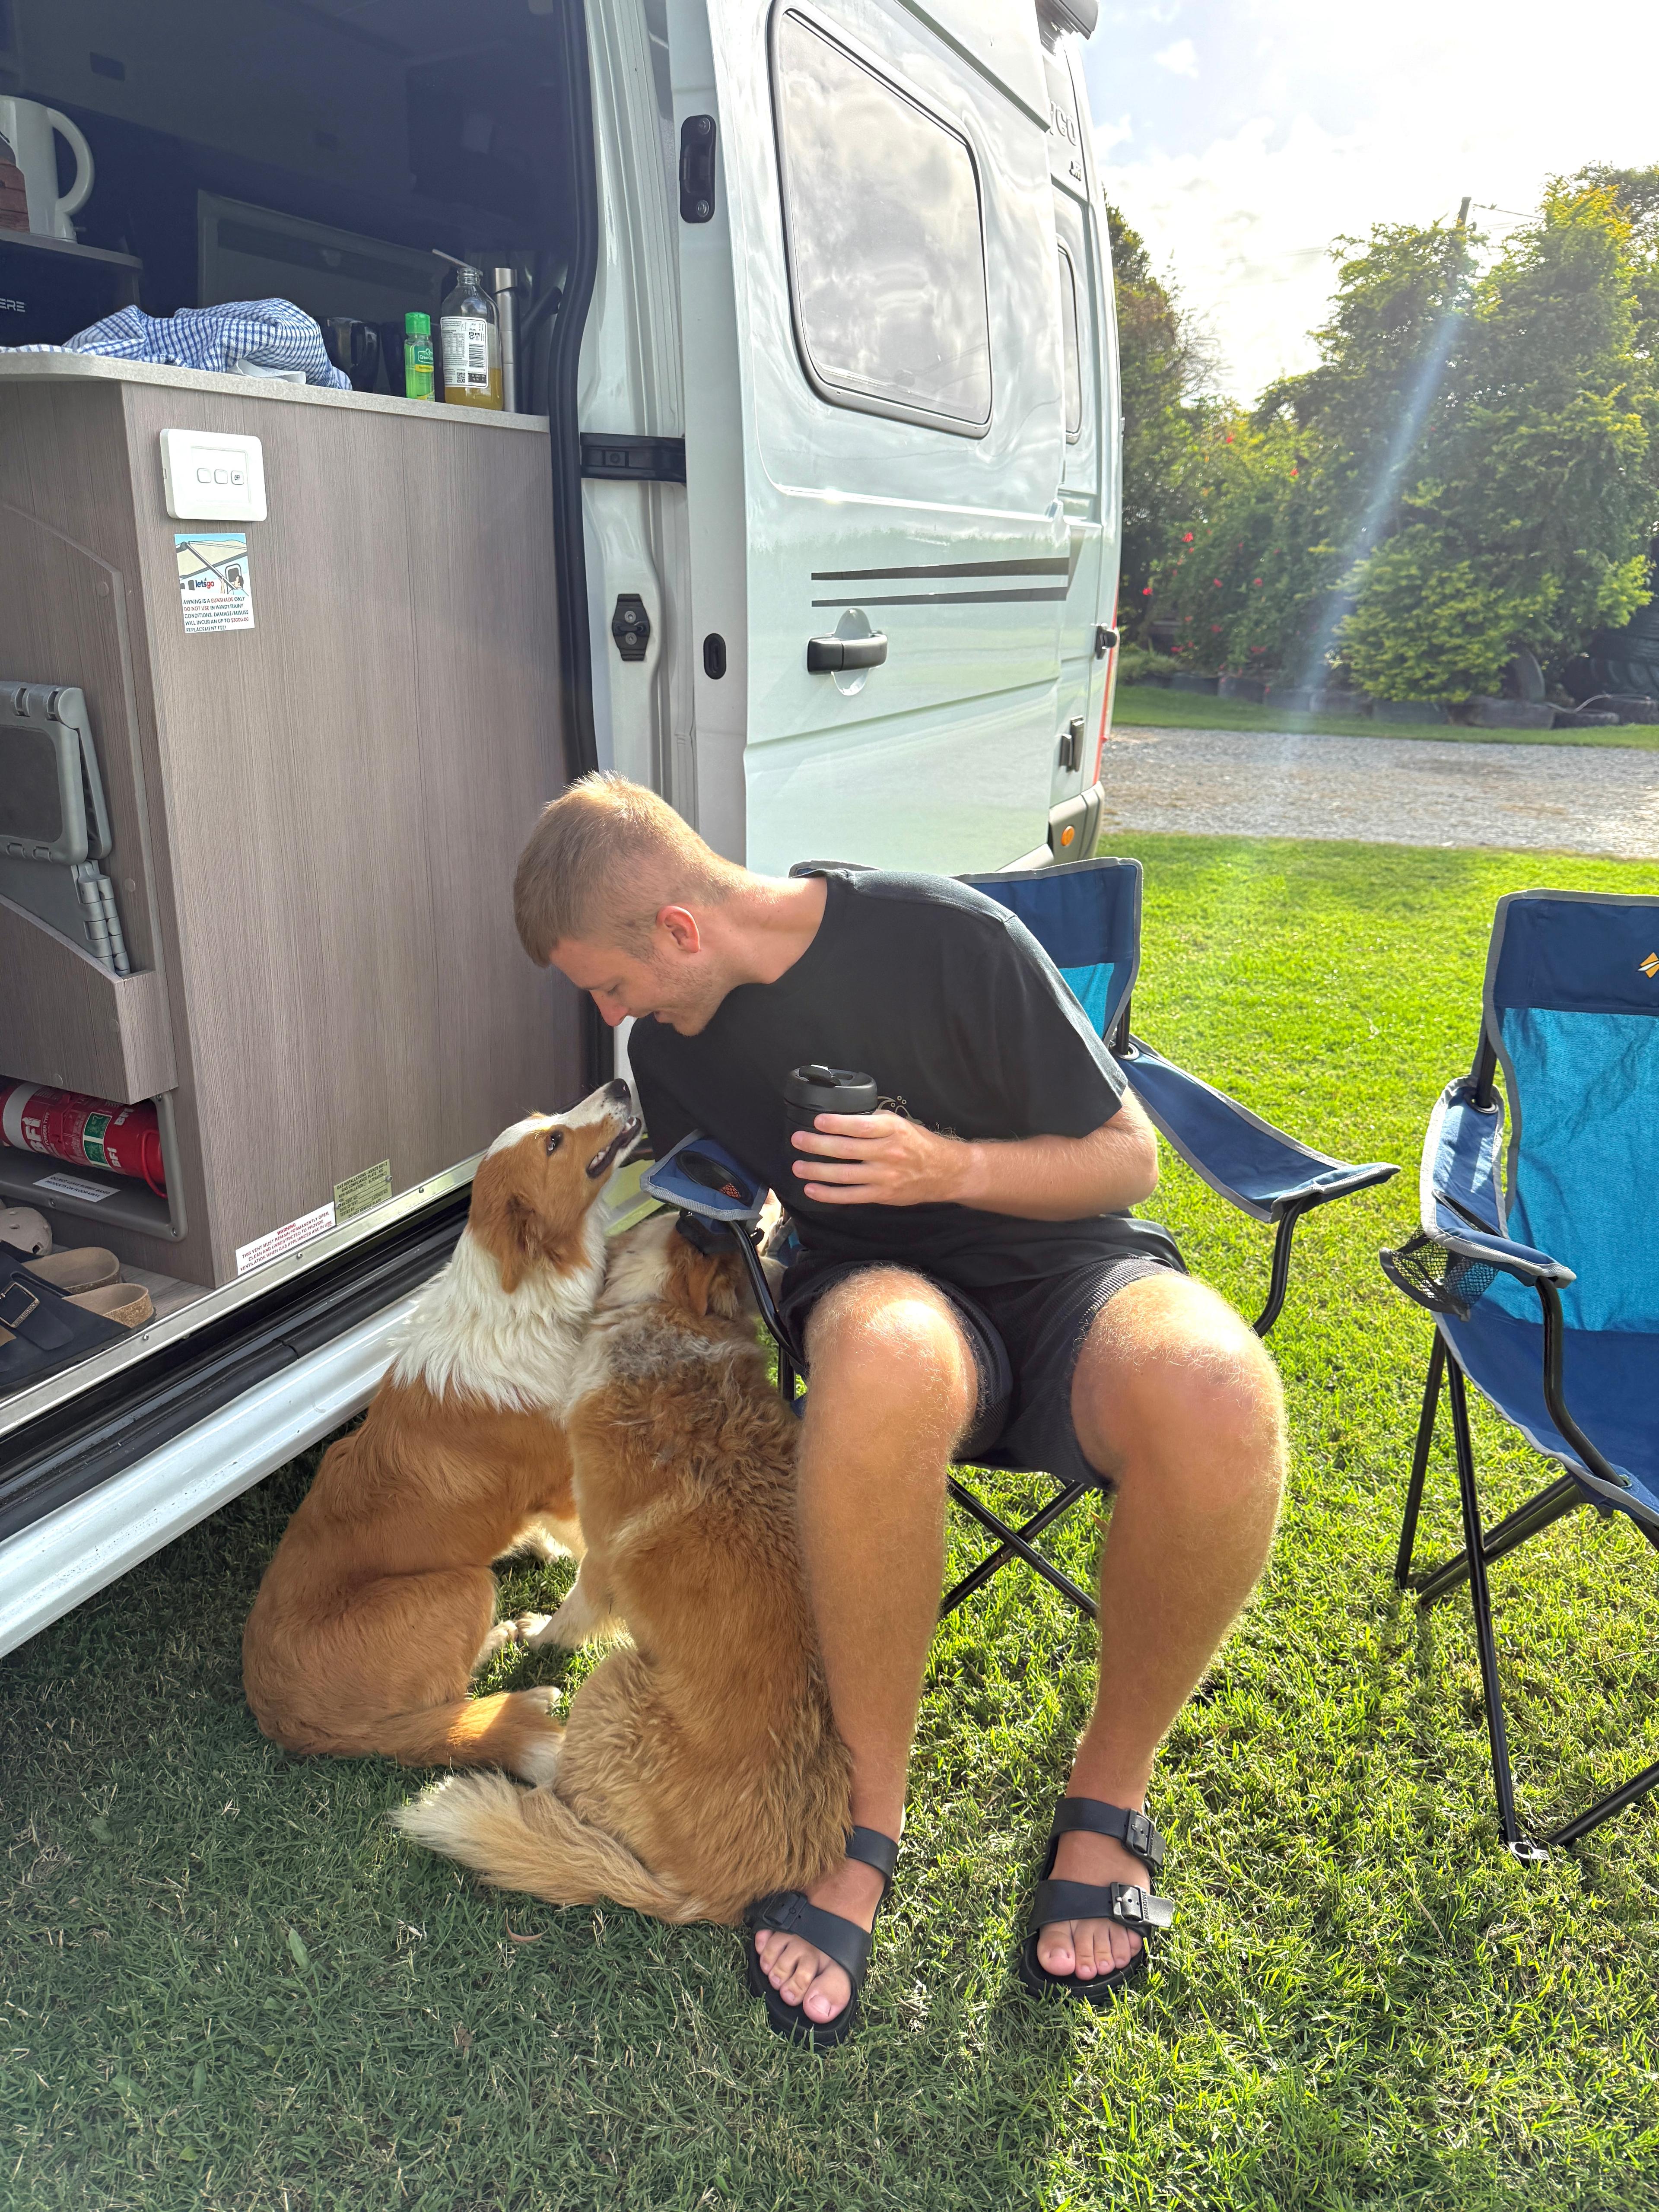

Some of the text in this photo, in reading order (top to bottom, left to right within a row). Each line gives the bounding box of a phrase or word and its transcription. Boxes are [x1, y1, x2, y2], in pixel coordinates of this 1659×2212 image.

[348, 1176, 367, 1189] COMPLIANCE
[248, 1251, 261, 1261] CLEAN
[272, 1231, 300, 1249] UNRESTRICTED
[307, 1220, 323, 1230] PROVIDE
[275, 1231, 290, 1241] REMAIN
[240, 1255, 265, 1271] VENTILATION
[288, 1231, 311, 1246] APPLIANCES
